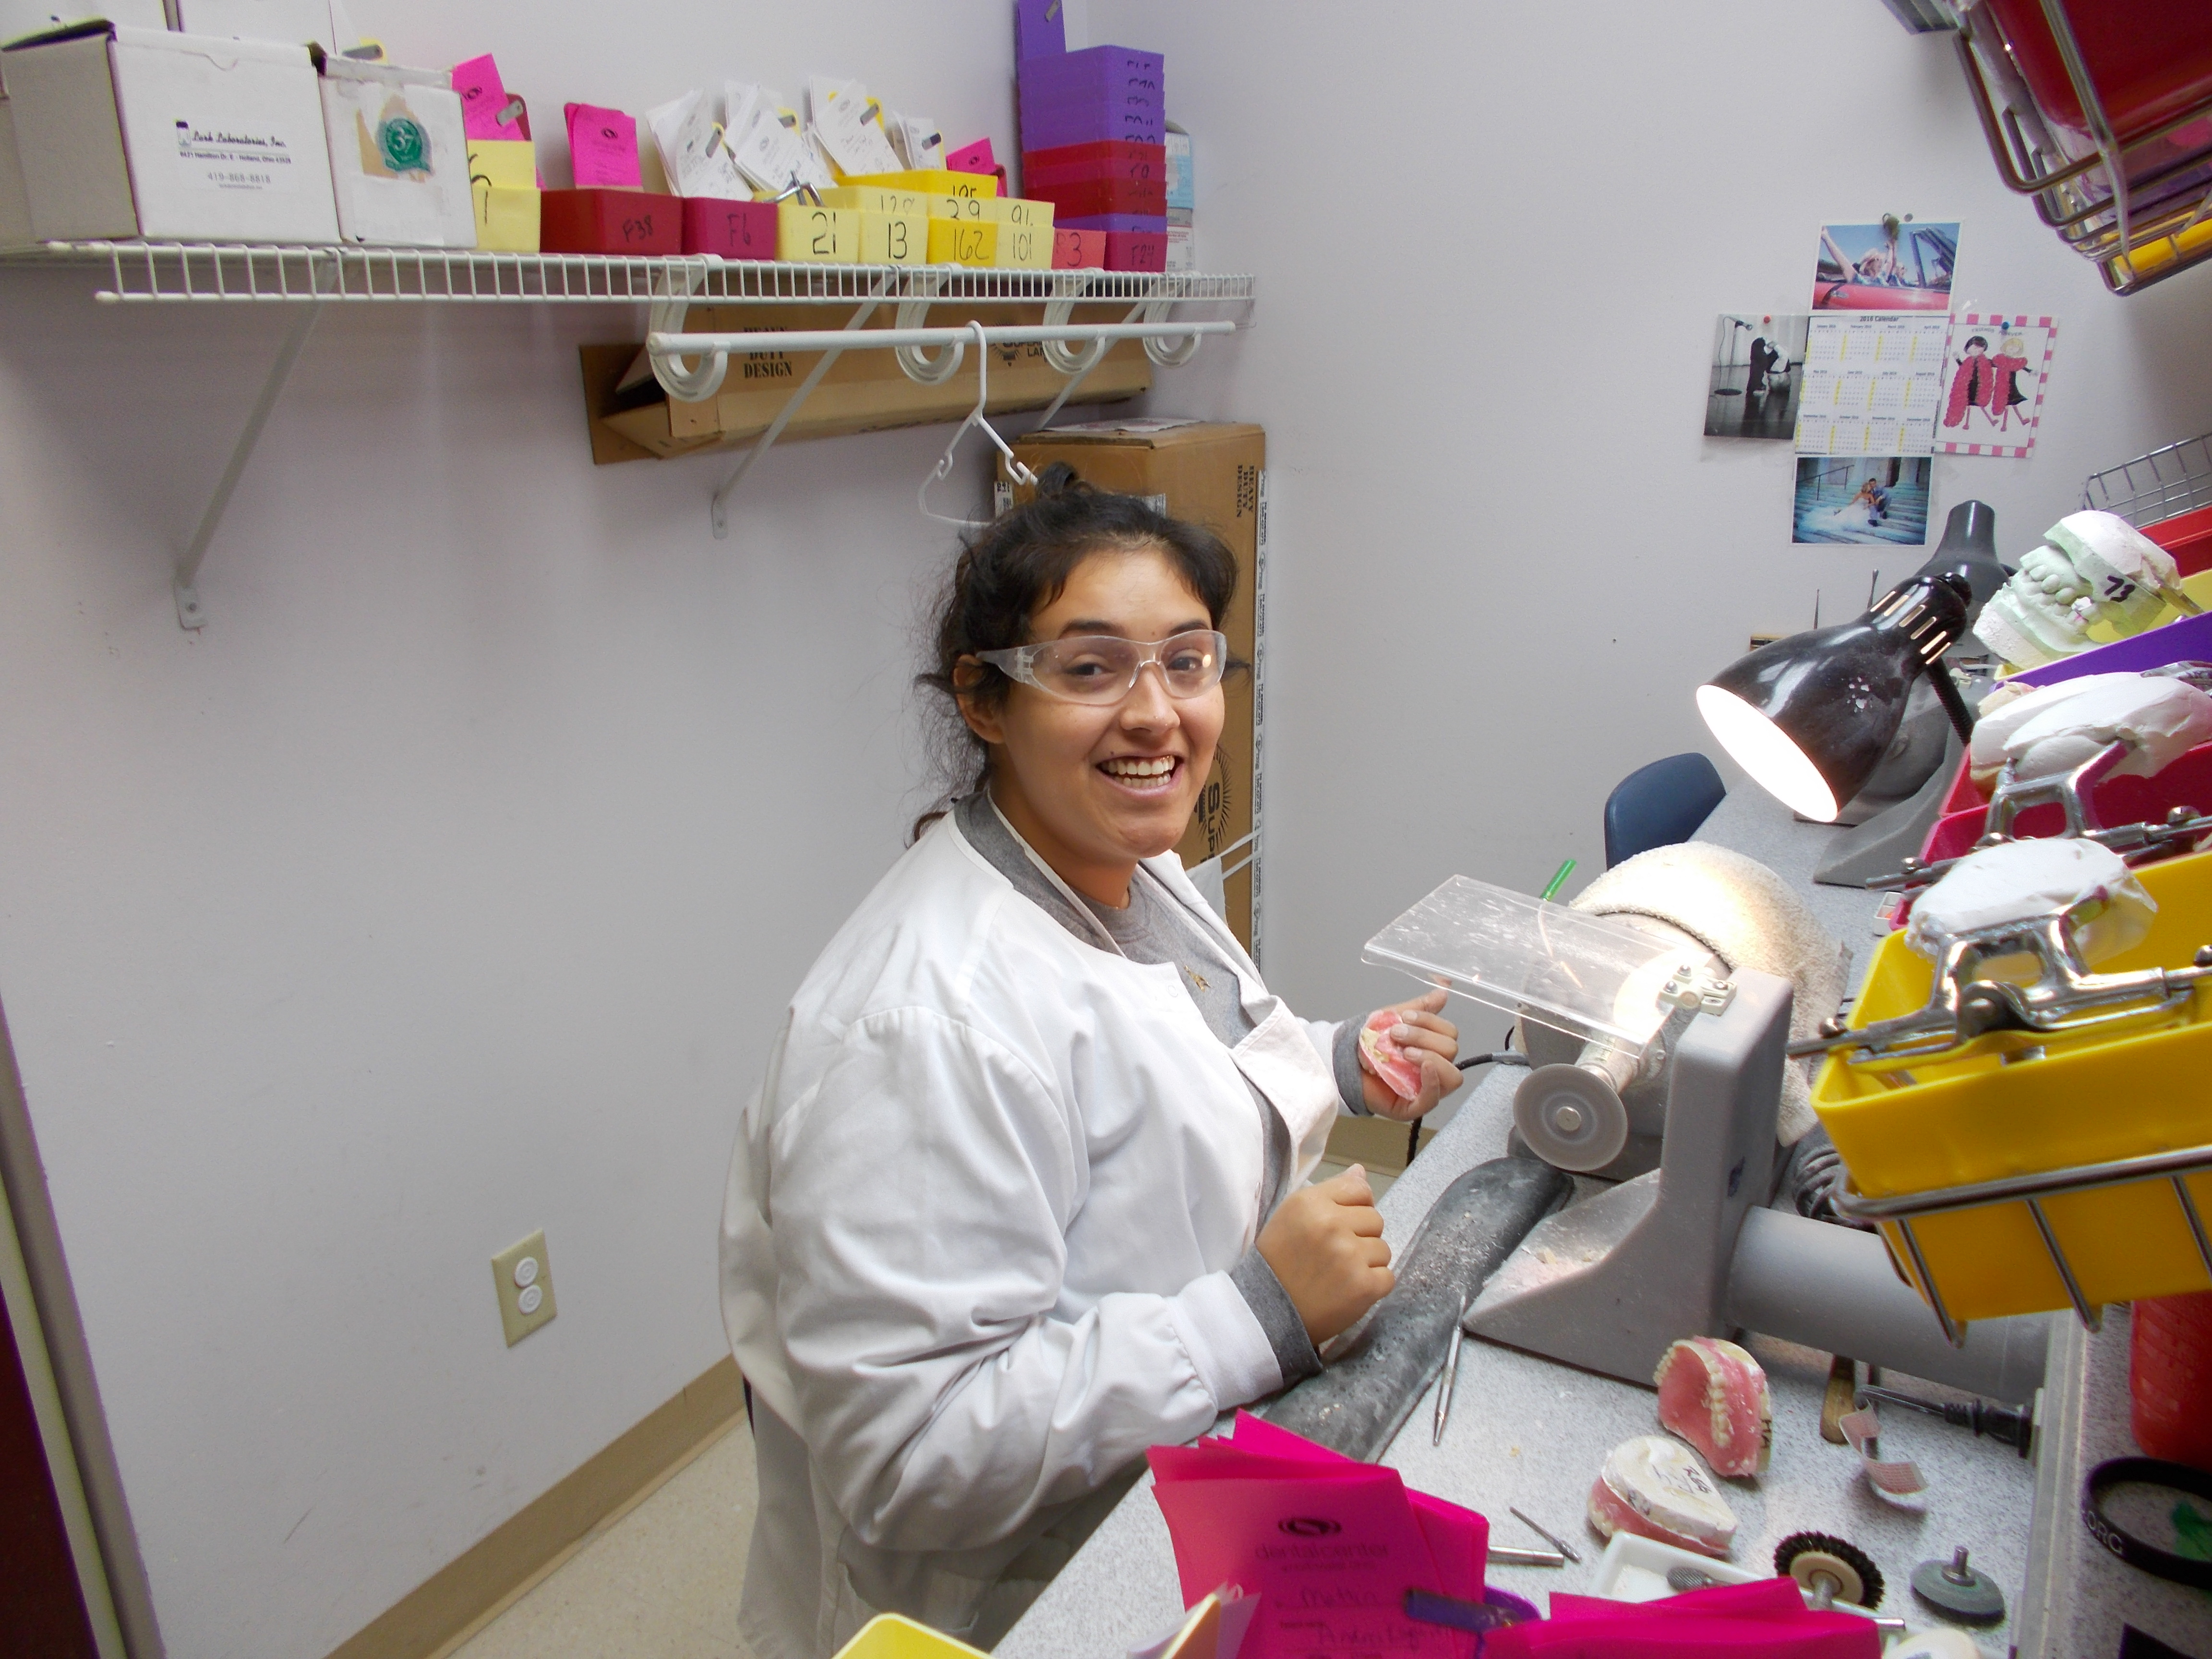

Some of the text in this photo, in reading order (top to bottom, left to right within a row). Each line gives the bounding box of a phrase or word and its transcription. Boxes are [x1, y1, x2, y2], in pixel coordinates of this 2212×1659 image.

[811, 211, 836, 255] 21
[888, 221, 907, 260] 13
[954, 228, 989, 261] 162
[1013, 233, 1032, 261] 101
[744, 361, 792, 378] DESIGN
[2104, 575, 2136, 603] 73
